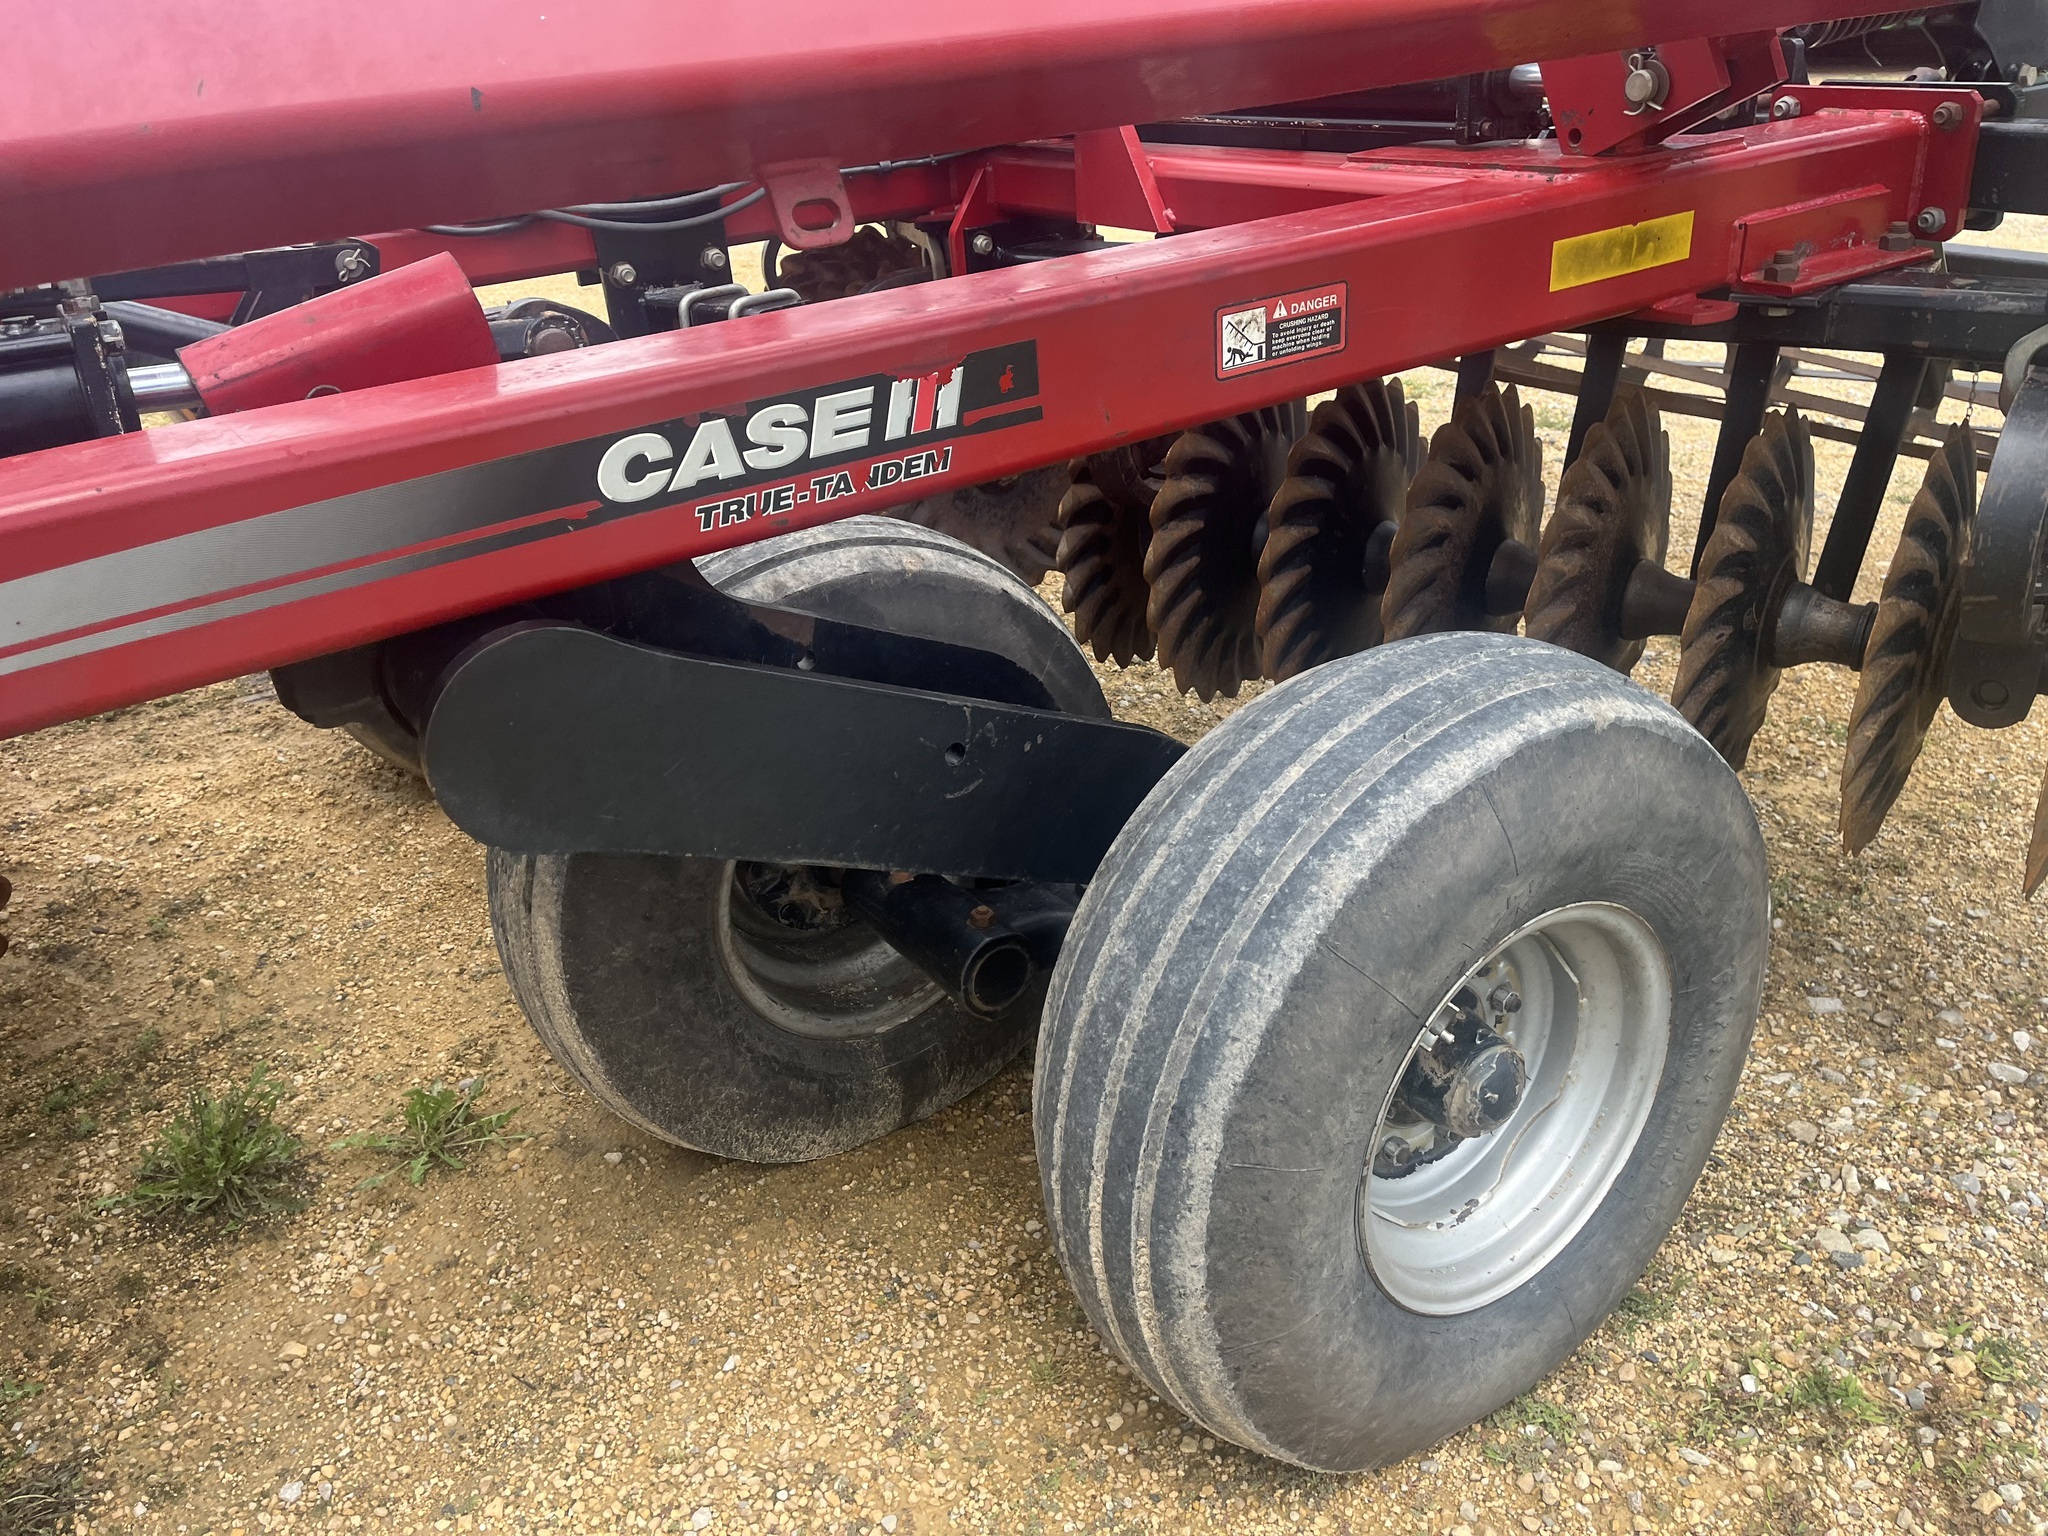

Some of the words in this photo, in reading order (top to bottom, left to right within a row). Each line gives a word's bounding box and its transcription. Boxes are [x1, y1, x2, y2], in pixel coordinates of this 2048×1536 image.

[1291, 294, 1338, 315] DANGER
[1279, 318, 1306, 329] CRUSHING
[1307, 312, 1329, 322] HAZARD
[1280, 328, 1295, 337] avoid
[1296, 325, 1312, 333] injury
[1320, 319, 1335, 327] death
[1271, 341, 1295, 351] machine
[1311, 333, 1330, 341] folding
[1286, 332, 1311, 341] everyone
[1279, 345, 1305, 355] unfolding
[1306, 341, 1324, 349] wings.
[597, 385, 875, 503] CASE
